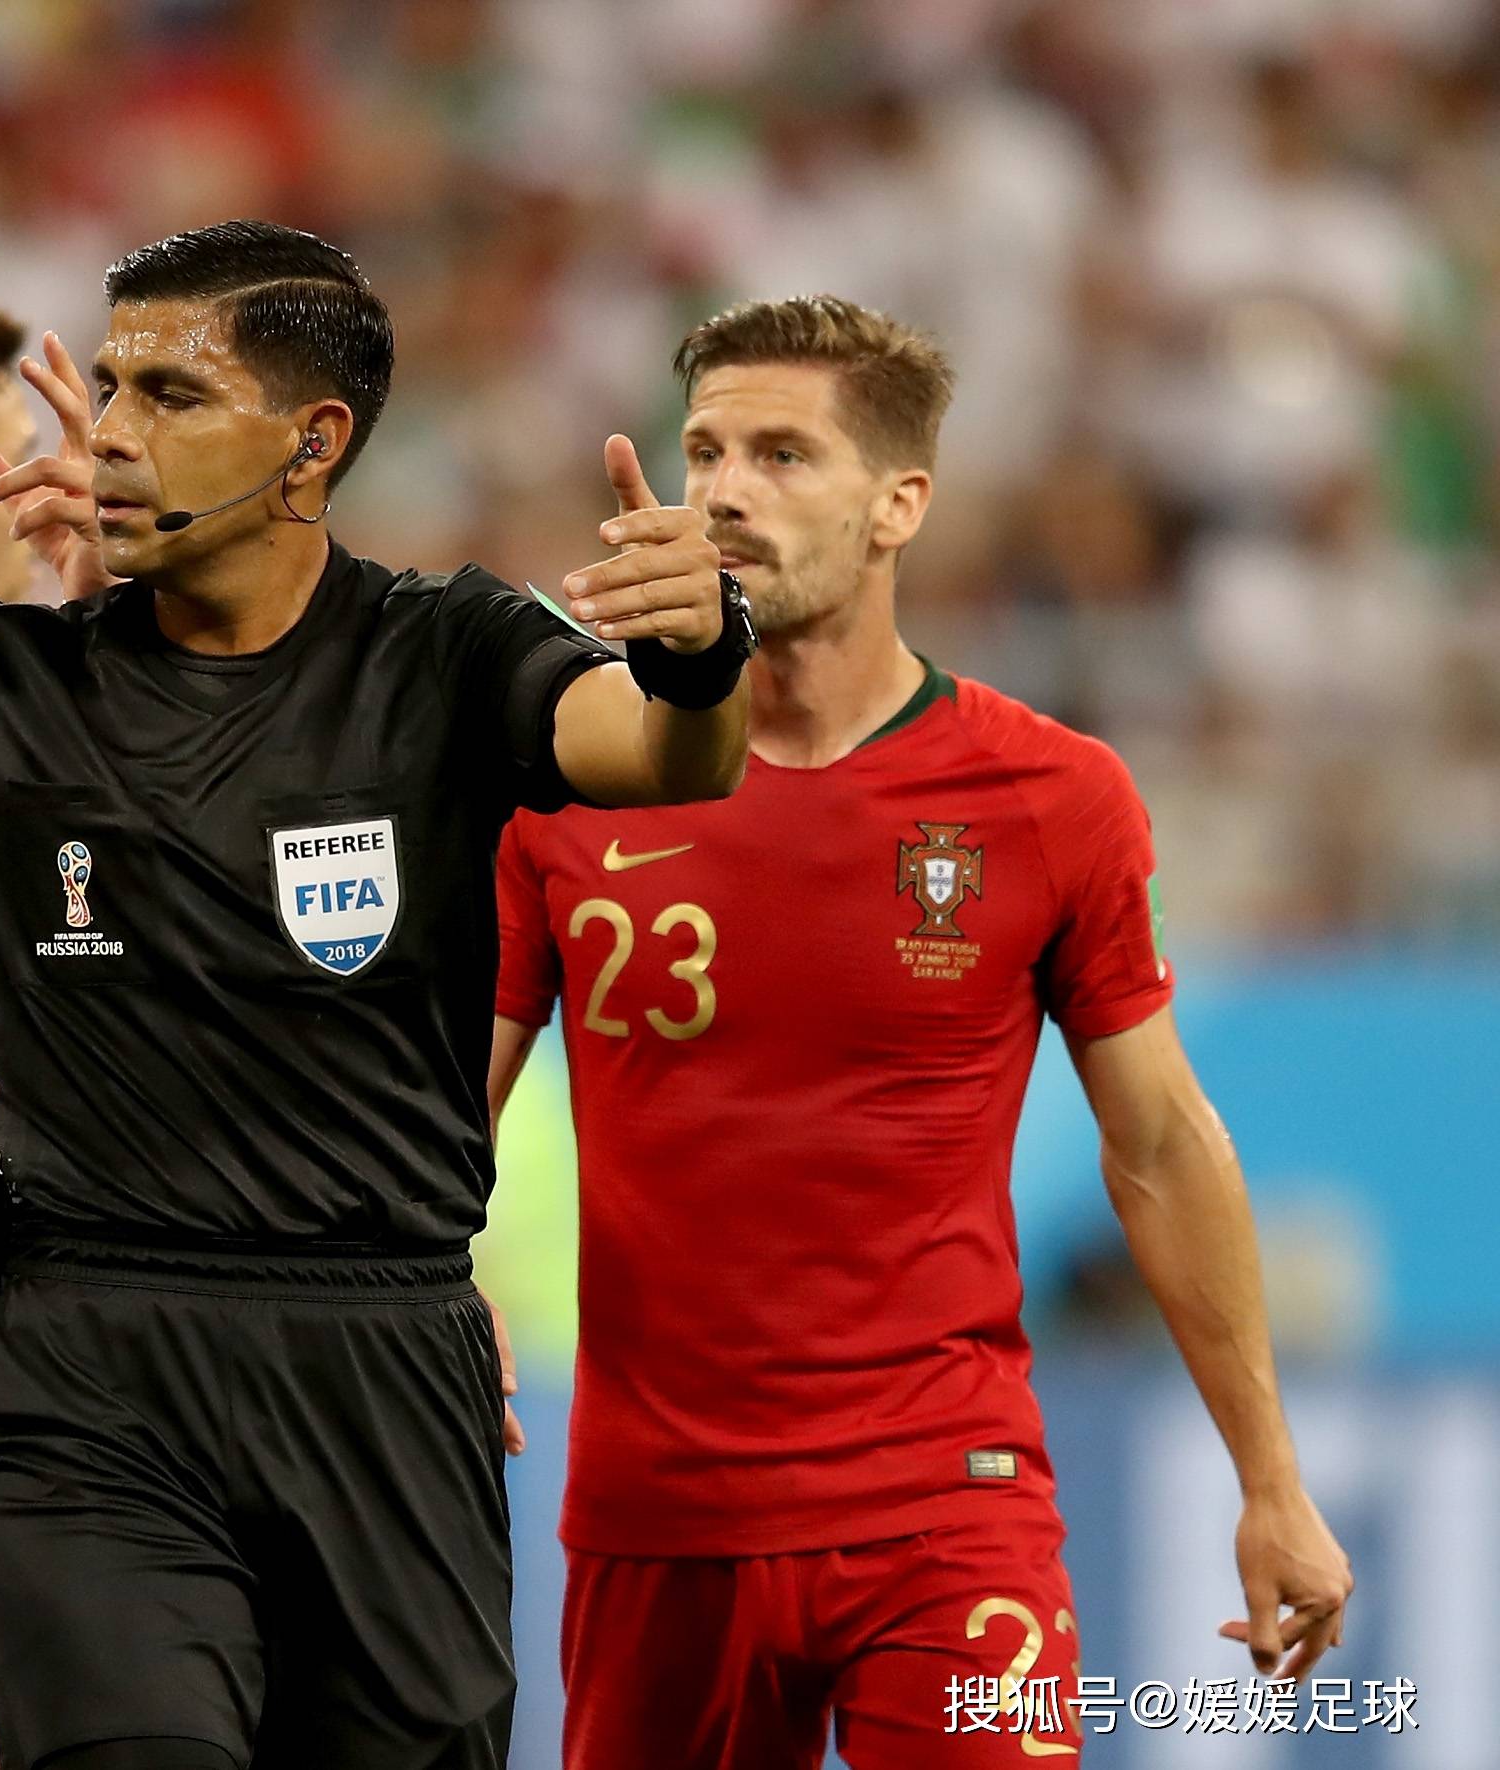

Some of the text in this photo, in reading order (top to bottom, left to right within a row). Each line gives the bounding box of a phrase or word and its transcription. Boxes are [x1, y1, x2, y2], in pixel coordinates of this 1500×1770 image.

[284, 832, 385, 860] REFEREE
[295, 877, 385, 916] FIFA
[36, 941, 124, 956] RUSSIA 2018
[325, 943, 366, 962] 2018
[568, 897, 717, 1040] 23
